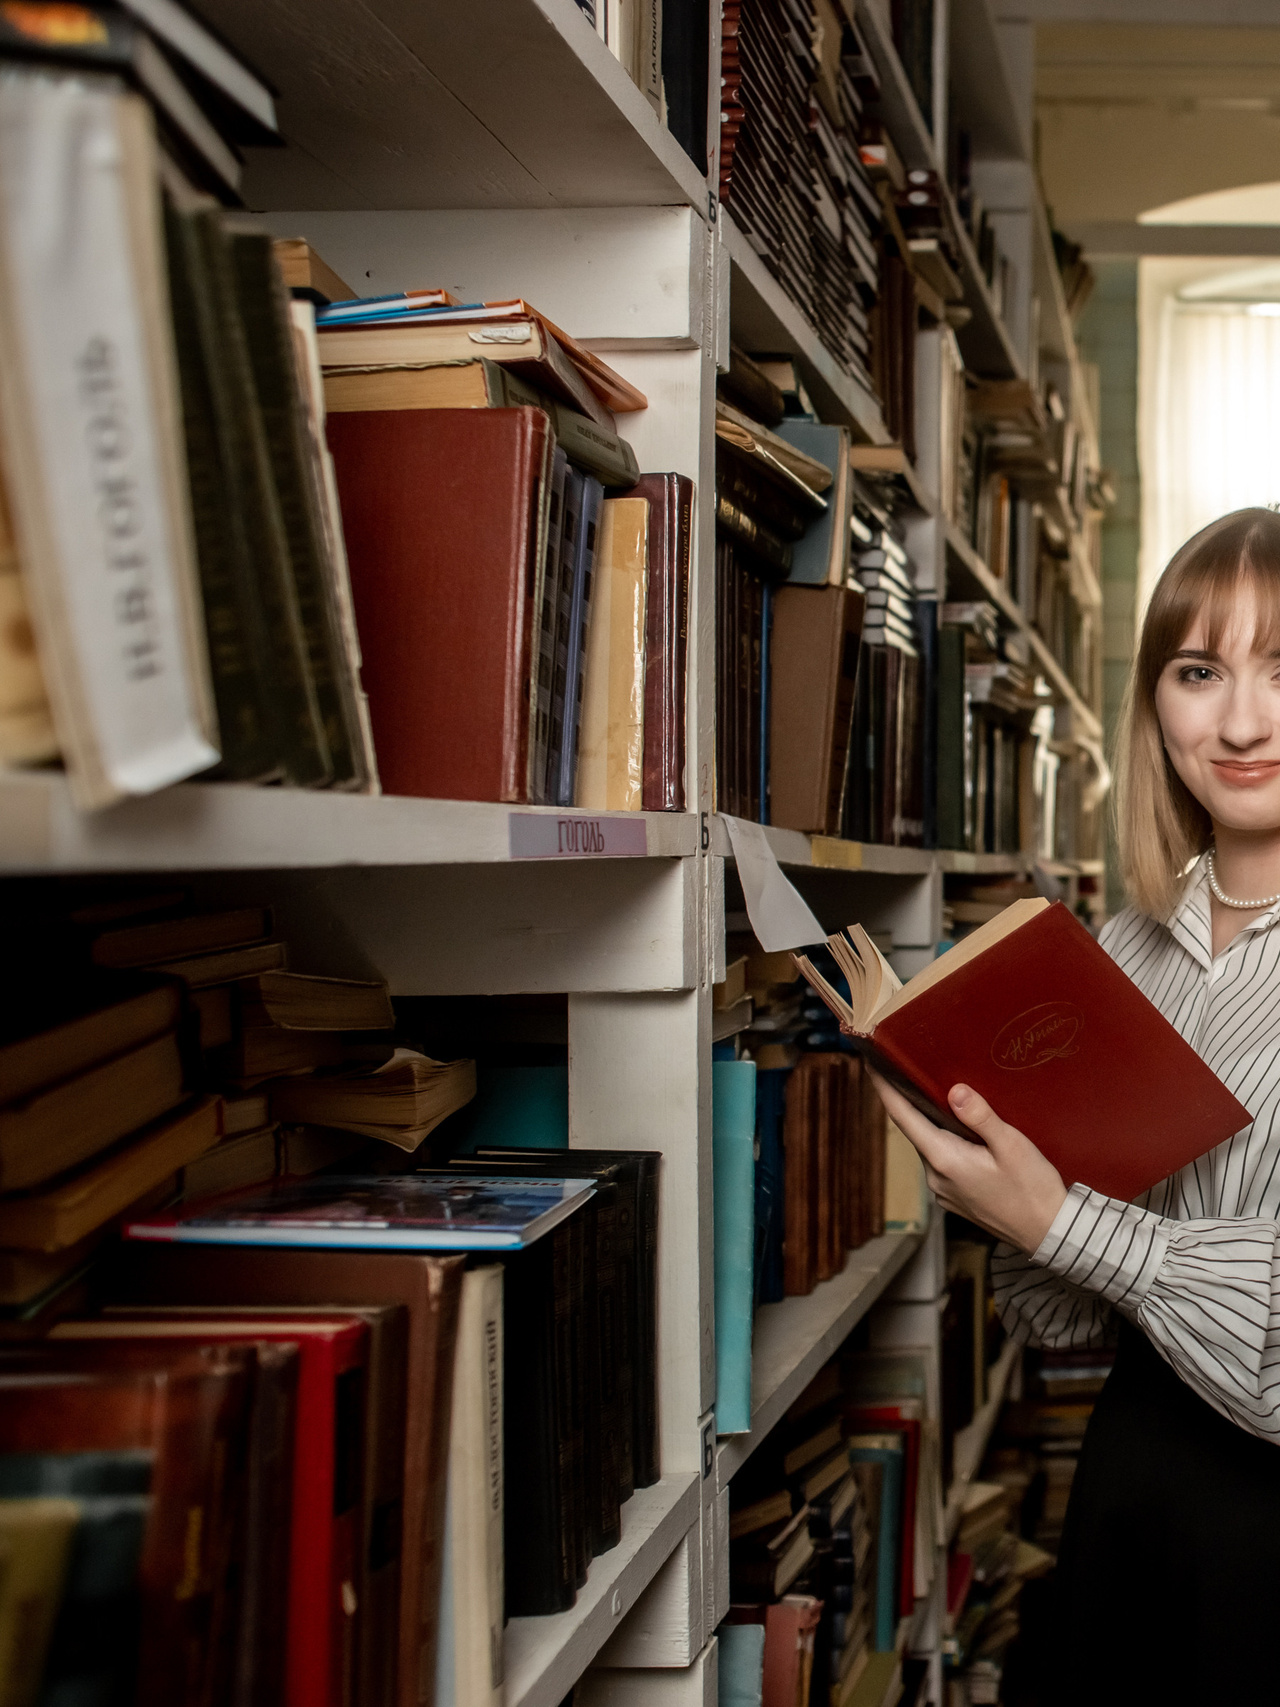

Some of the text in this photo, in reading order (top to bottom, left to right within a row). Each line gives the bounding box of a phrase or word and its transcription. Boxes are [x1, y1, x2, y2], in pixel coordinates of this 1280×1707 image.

[679, 504, 690, 639] Вечера на хуторе близ
[557, 819, 606, 854] ГОГОЛЬ
